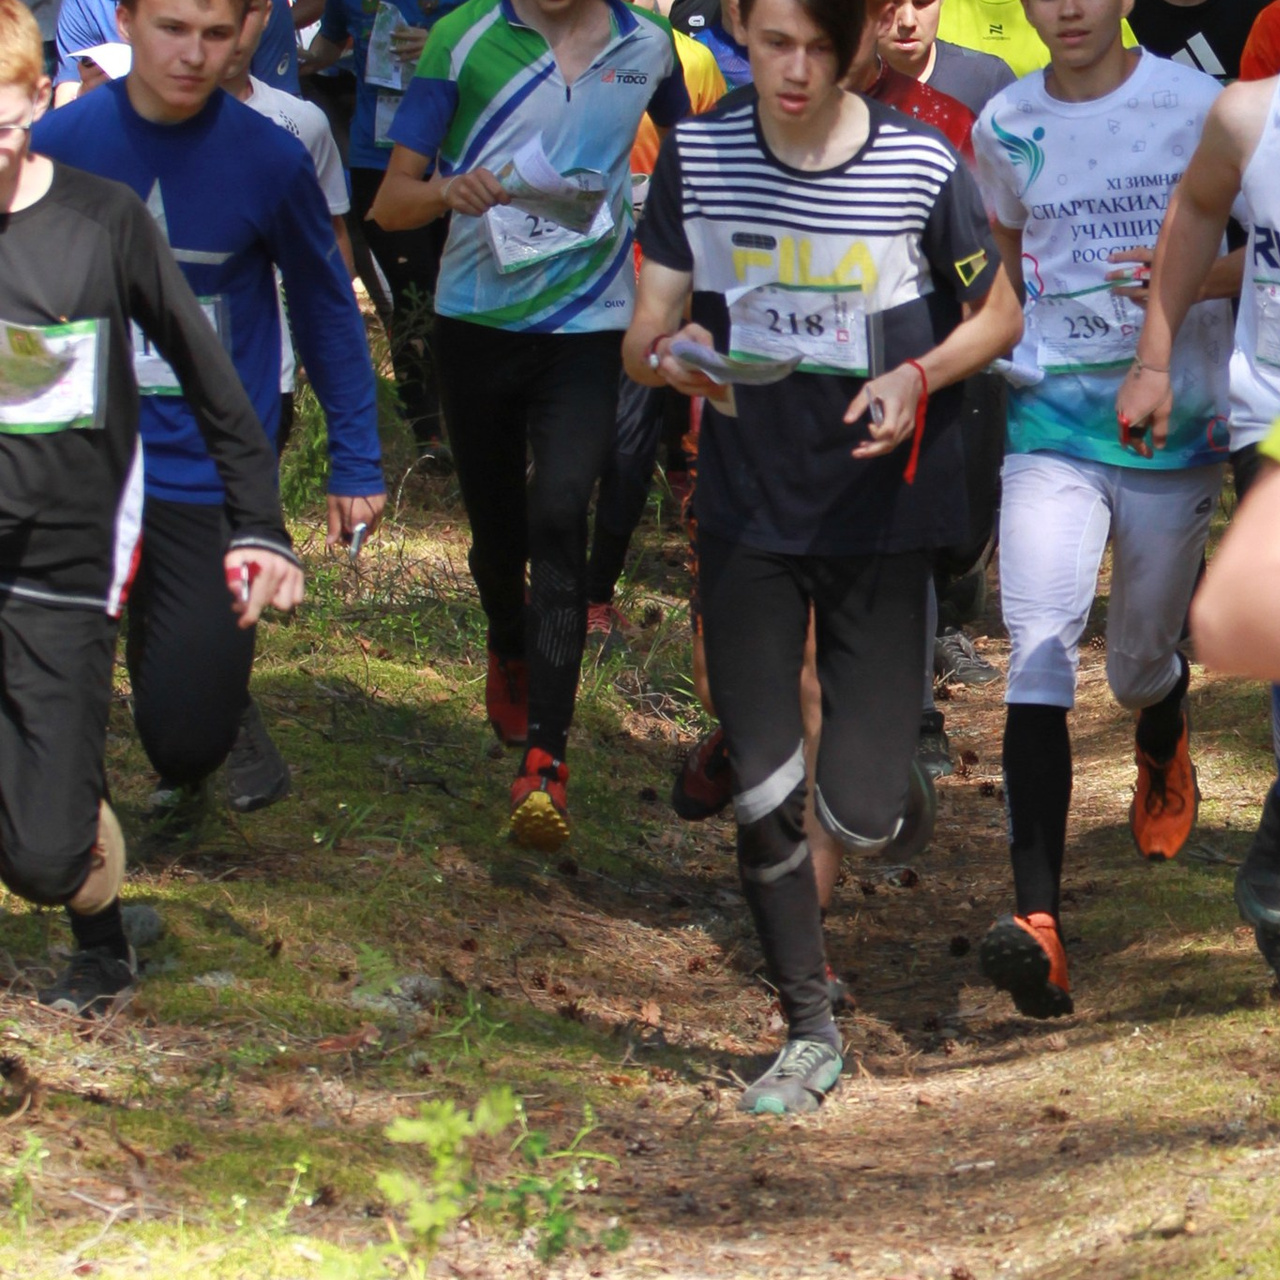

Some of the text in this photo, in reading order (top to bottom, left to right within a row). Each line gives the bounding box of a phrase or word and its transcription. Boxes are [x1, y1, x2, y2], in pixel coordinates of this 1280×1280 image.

[732, 235, 879, 296] FILA
[766, 308, 825, 337] 218
[1064, 315, 1110, 339] 239
